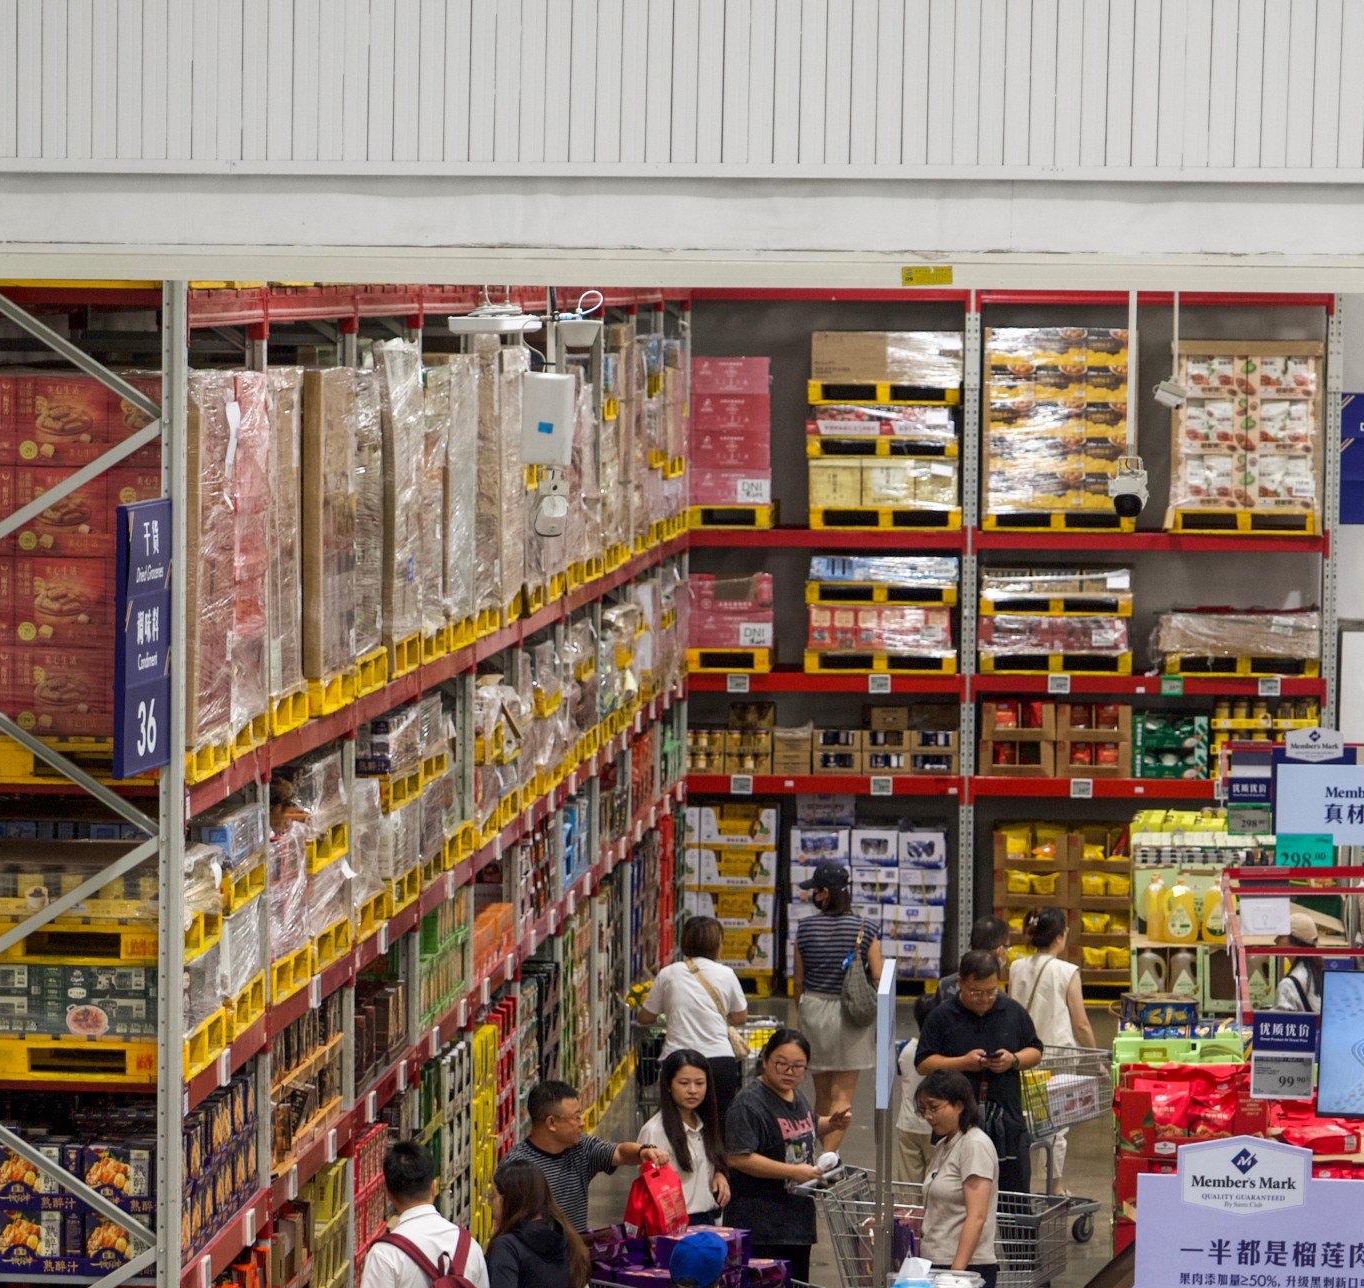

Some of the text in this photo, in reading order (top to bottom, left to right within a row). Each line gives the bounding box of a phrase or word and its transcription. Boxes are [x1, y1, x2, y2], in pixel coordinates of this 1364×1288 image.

[143, 519, 160, 557] 干货
[136, 566, 147, 585] Dried
[136, 605, 160, 646] 调味料
[137, 652, 158, 672] Condiment
[136, 697, 157, 758] 36
[1325, 803, 1364, 825] 真材
[1260, 1022, 1311, 1038] 优质优价
[1191, 1174, 1297, 1191] Member's Mark
[1201, 1193, 1286, 1202] QUALITY GUARANTEED
